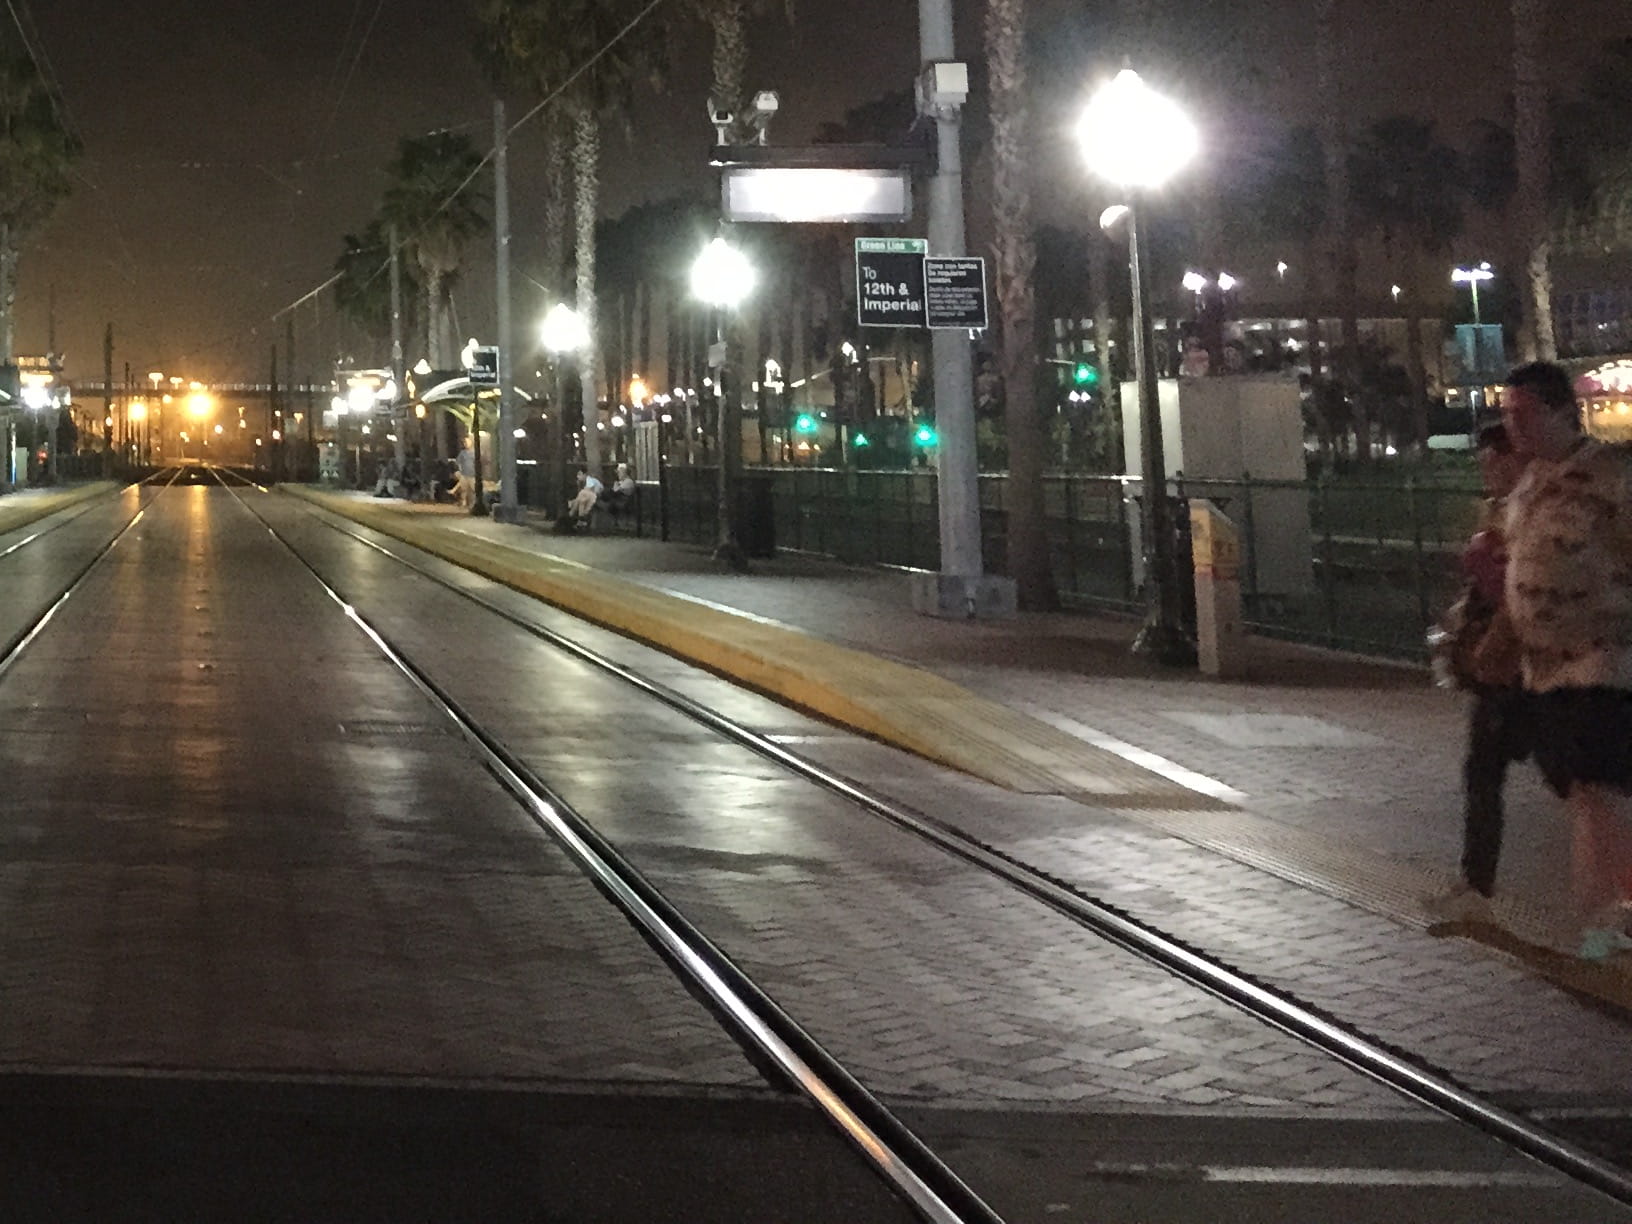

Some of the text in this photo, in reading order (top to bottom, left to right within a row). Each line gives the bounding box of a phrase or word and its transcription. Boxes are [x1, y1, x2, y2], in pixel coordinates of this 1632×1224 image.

[862, 265, 877, 280] To
[863, 282, 910, 296] 12th &
[863, 296, 922, 314] Imperial
